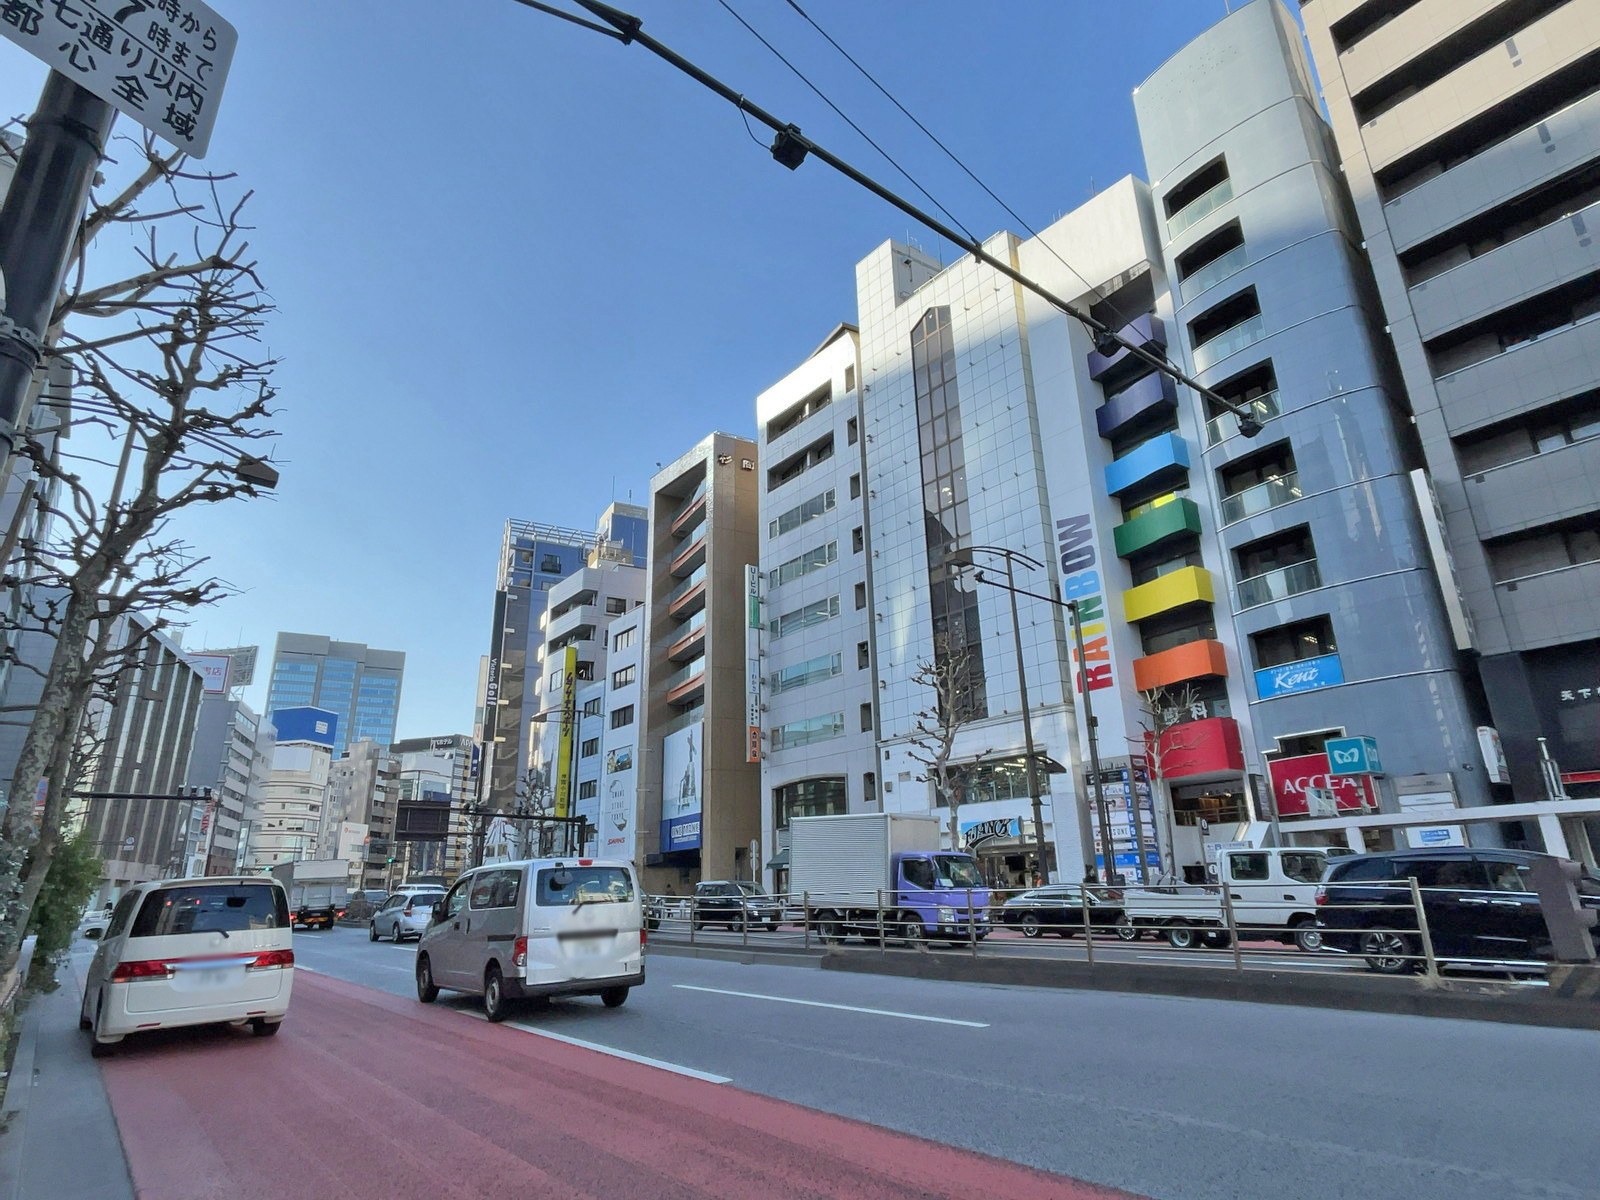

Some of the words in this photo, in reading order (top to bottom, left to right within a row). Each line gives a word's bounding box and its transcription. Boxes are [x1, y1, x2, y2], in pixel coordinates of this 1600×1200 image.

[1056, 513, 1114, 694] RAINBOW
[489, 658, 497, 682] Victoria
[1274, 667, 1320, 689] Kent
[486, 683, 498, 706] Golf
[1560, 686, 1600, 701] 天下
[1283, 773, 1358, 795] ACCEA
